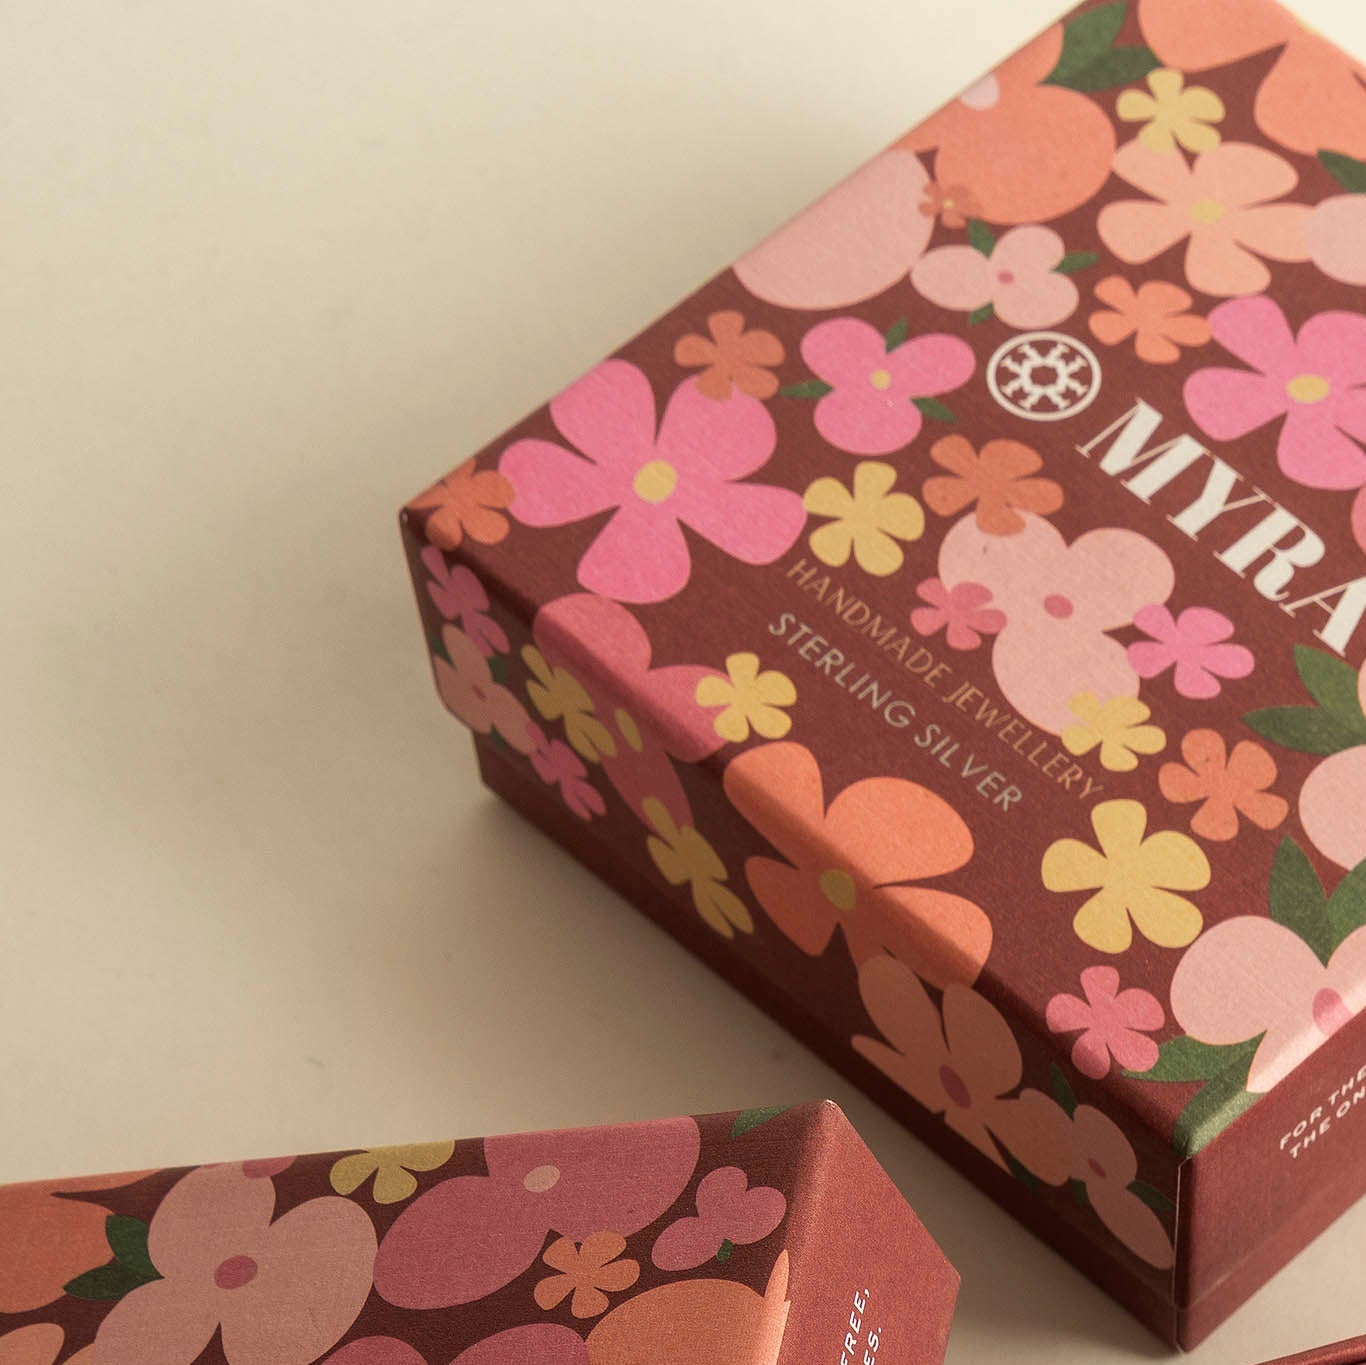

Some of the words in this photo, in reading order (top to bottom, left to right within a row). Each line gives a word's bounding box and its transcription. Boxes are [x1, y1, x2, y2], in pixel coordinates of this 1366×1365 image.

[768, 611, 918, 730] STERLING
[913, 723, 1024, 813] SILVER
[786, 558, 953, 690] HANDMADE
[942, 680, 1105, 803] JEWELLERY
[1279, 1106, 1322, 1149] FOR
[1290, 1116, 1331, 1158] THE
